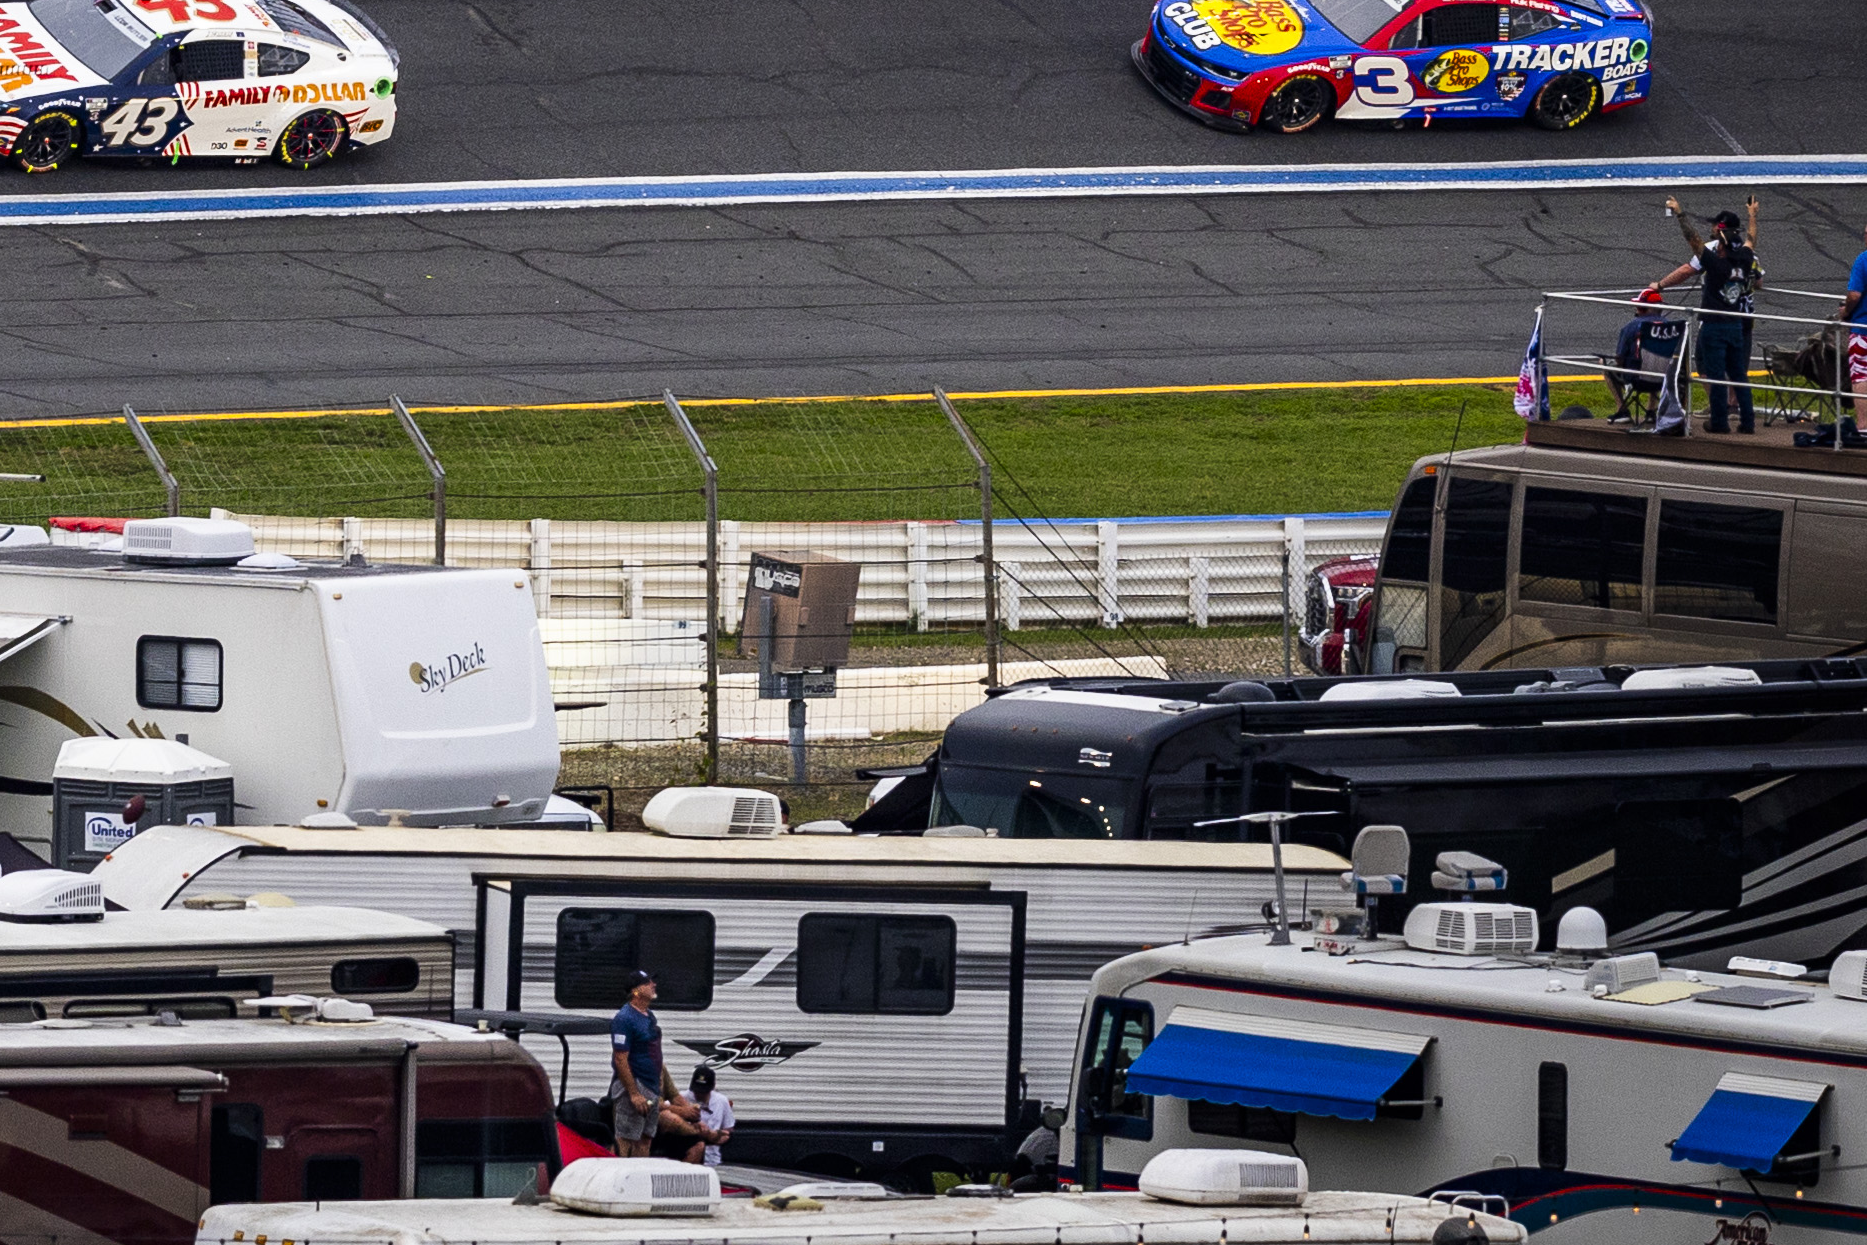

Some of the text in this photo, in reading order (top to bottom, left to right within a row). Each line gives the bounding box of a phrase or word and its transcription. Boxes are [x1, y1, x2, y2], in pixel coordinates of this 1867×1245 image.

[1164, 1, 1222, 51] CLUB
[1449, 63, 1469, 76] Pro
[1452, 52, 1478, 66] Bass
[1491, 37, 1631, 72] TRACKER
[1602, 59, 1648, 82] BOATS
[203, 81, 367, 110] FAMILY DOLLAR
[1354, 56, 1416, 105] 3
[1446, 73, 1480, 88] Shops
[100, 98, 180, 149] 43
[417, 642, 486, 694] Sky Deck
[92, 823, 133, 838] United
[695, 1035, 782, 1071] Shasta
